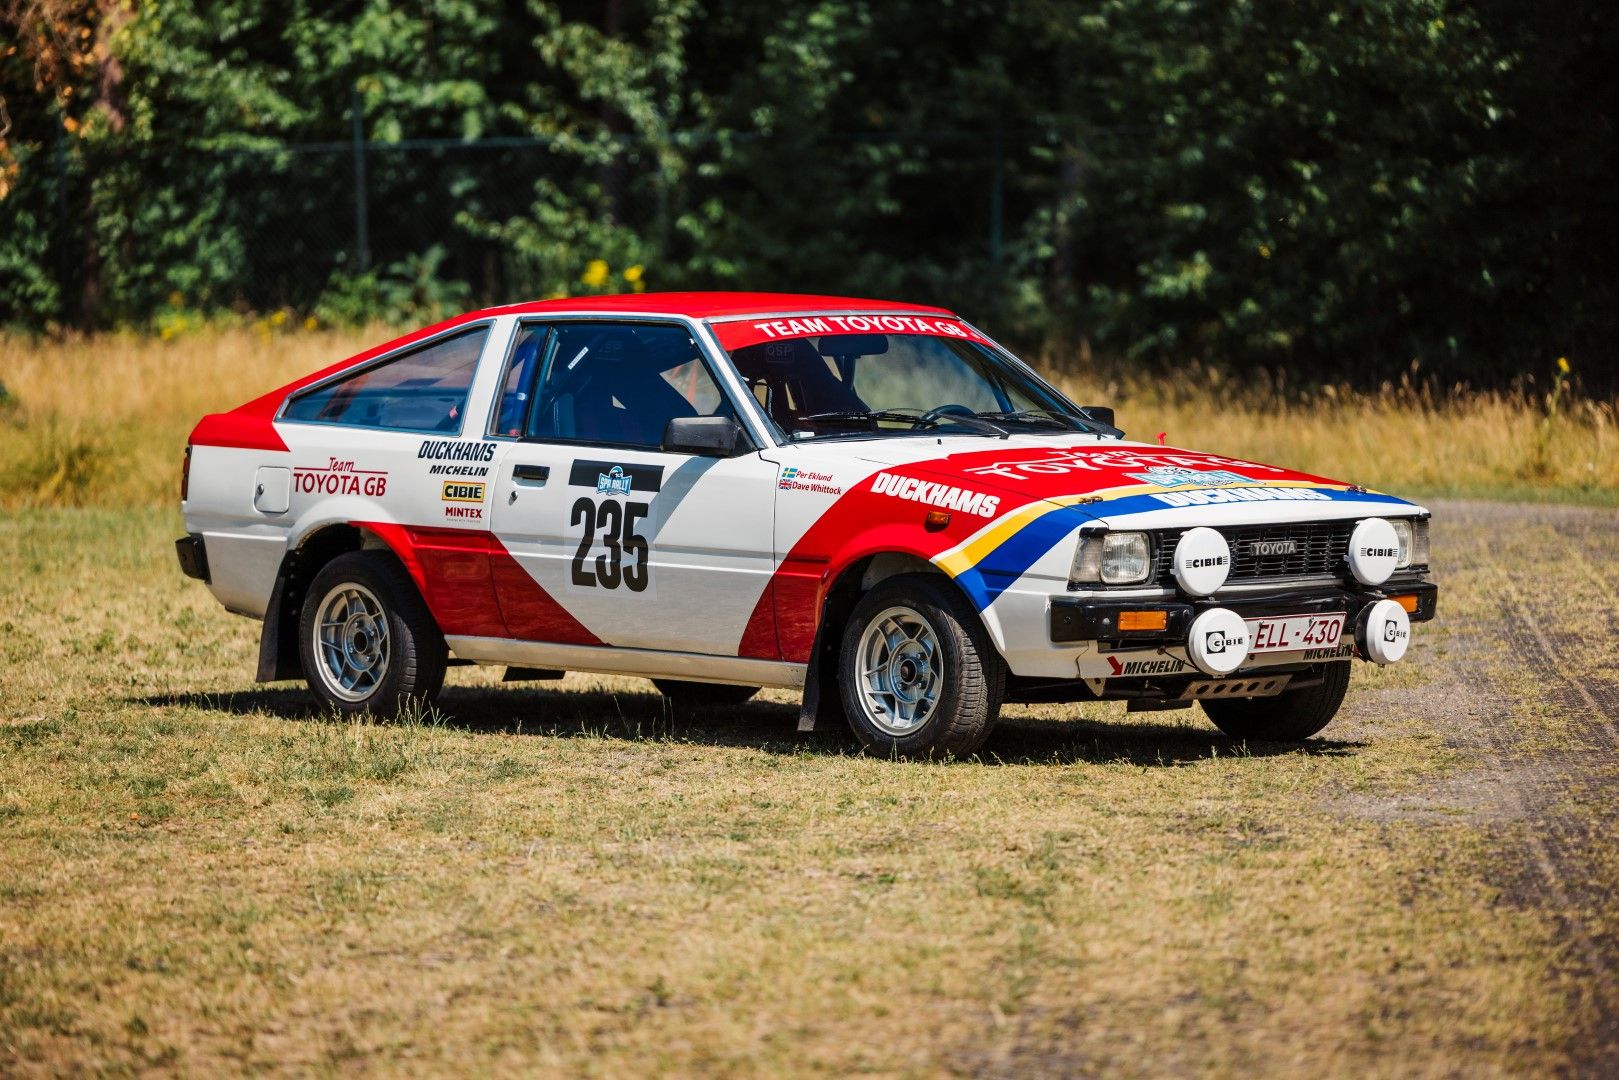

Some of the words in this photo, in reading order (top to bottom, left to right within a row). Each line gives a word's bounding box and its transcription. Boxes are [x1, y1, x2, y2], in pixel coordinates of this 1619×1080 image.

[754, 318, 830, 338] TEAM
[828, 316, 938, 334] TOYOTA
[934, 321, 969, 338] GB
[417, 440, 498, 462] DUCKHAMS
[328, 457, 355, 473] Team
[429, 465, 489, 477] MICHELIN
[974, 456, 1222, 480] TOYOTA
[293, 473, 361, 495] TOYOTA
[363, 477, 388, 497] GB
[795, 470, 808, 479] Per
[808, 472, 833, 482] Eklund
[792, 481, 810, 491] Dave
[810, 483, 842, 496] Whittock
[870, 472, 1001, 519] DUCKHAMS
[1149, 486, 1333, 508] DUCKHAMS
[445, 506, 483, 519] MINTEX
[570, 496, 649, 593] 235
[1254, 541, 1297, 556] TOYOTA
[1302, 643, 1352, 661] MICHELIN
[1123, 659, 1185, 675] MICHELIN
